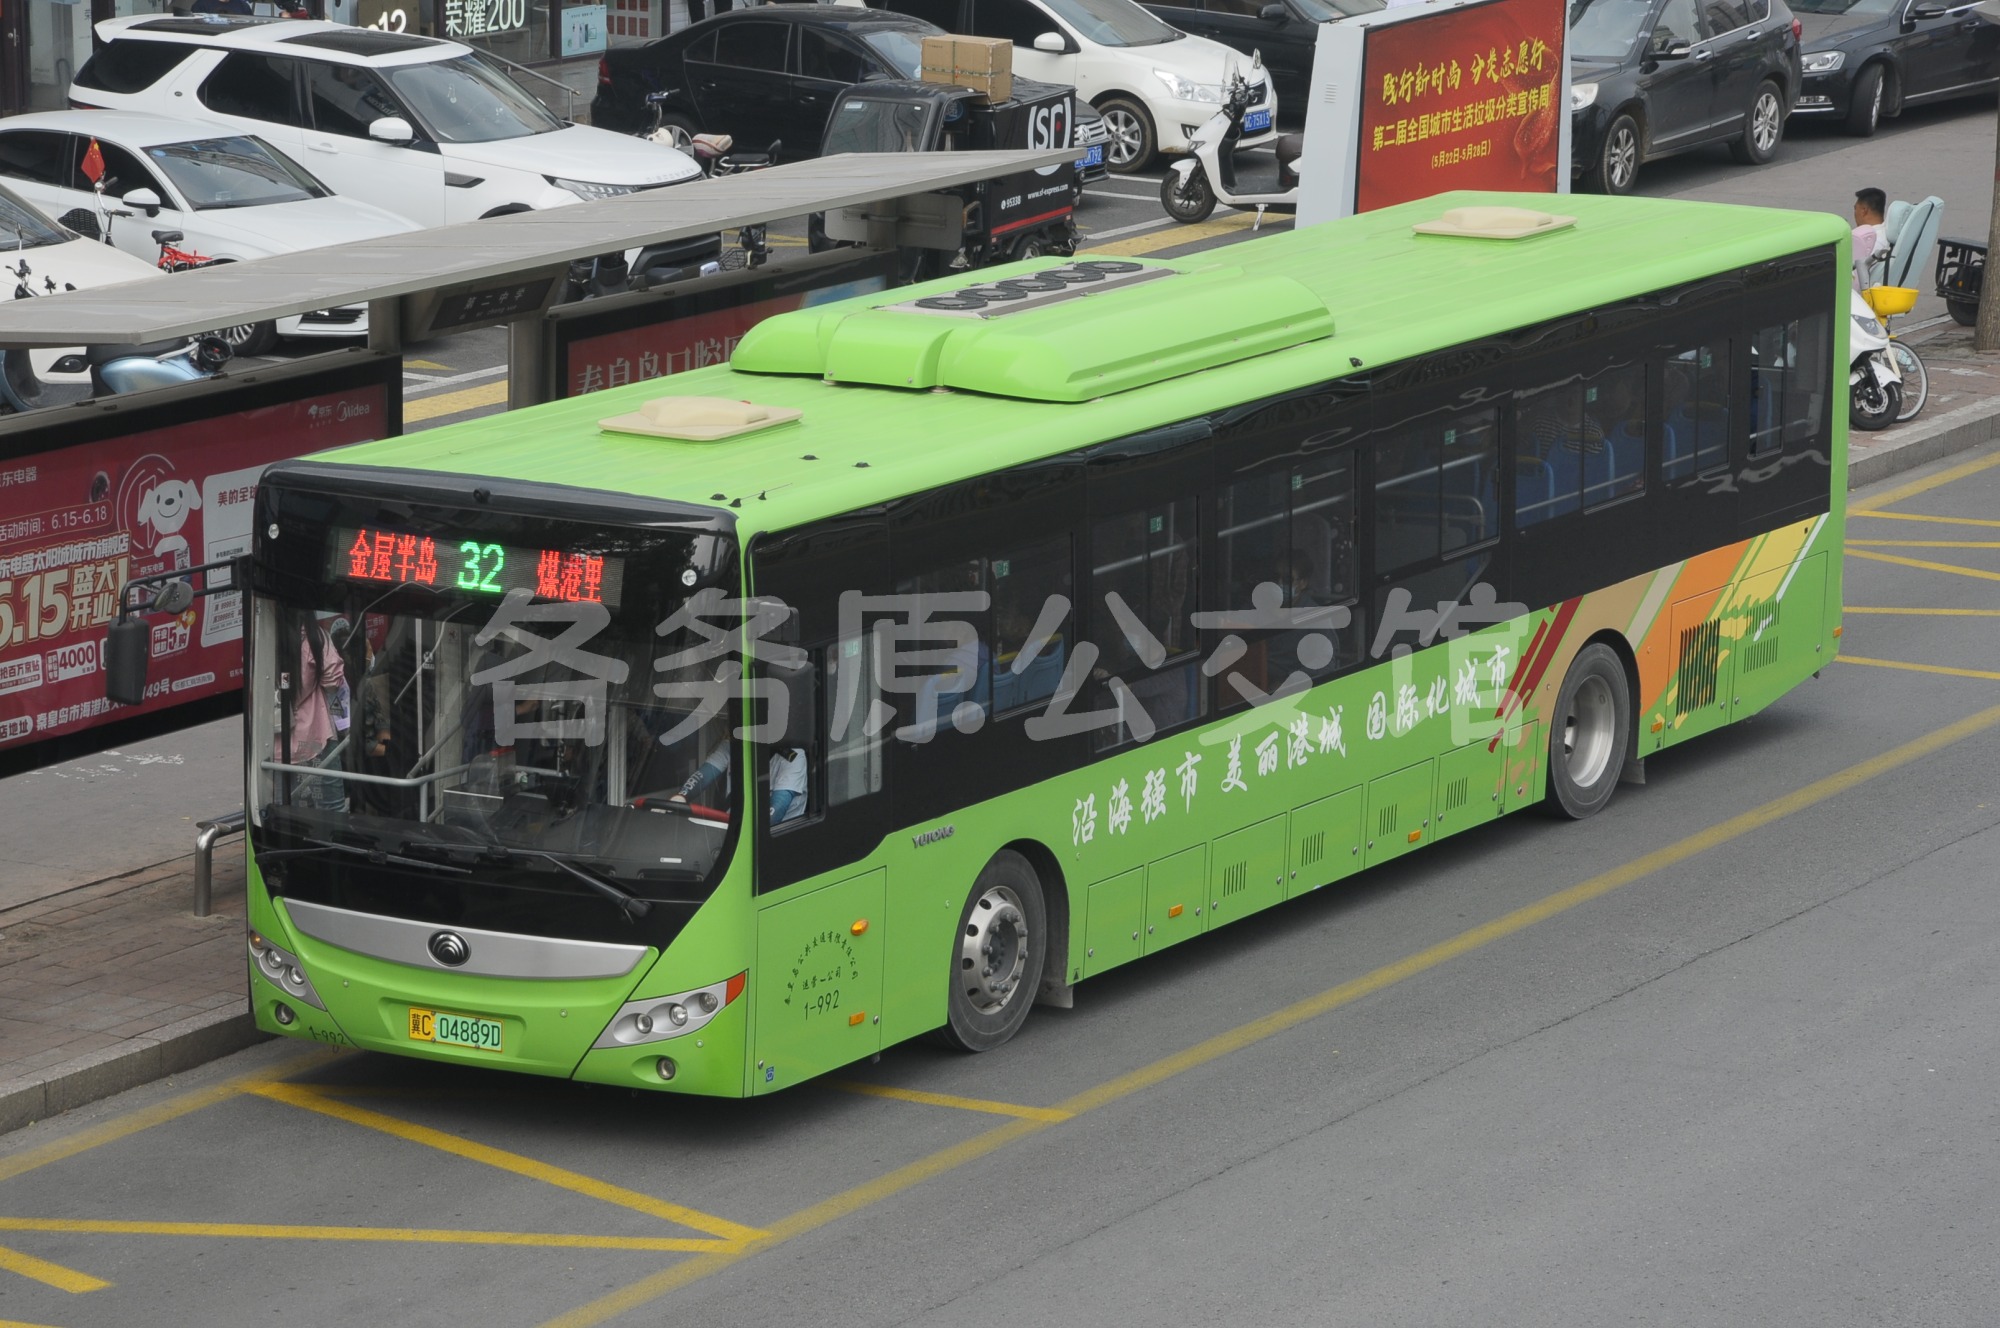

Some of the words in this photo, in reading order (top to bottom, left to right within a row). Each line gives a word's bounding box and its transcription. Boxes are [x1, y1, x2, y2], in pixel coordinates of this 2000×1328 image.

[446, 0, 525, 36] 荣耀200
[1383, 60, 1461, 105] 践行新时尚
[1470, 37, 1545, 85] 分类志愿行
[1373, 84, 1550, 151] 第二届全国城市生活垃圾分类宣传周
[338, 401, 370, 421] Midea
[0, 466, 37, 487] 东电器
[51, 505, 107, 530] 6.15-6.18
[349, 529, 437, 585] 金屋半岛
[457, 541, 505, 593] 32
[72, 561, 116, 598] 盛大
[59, 644, 95, 670] 4000
[1072, 752, 1202, 847] 沿海强市
[1221, 705, 1346, 793] 美丽港城
[1366, 645, 1512, 741] 国际化城市
[912, 824, 954, 849] YUTONG
[804, 989, 839, 1021] 1-992
[309, 1025, 347, 1045] 1-992
